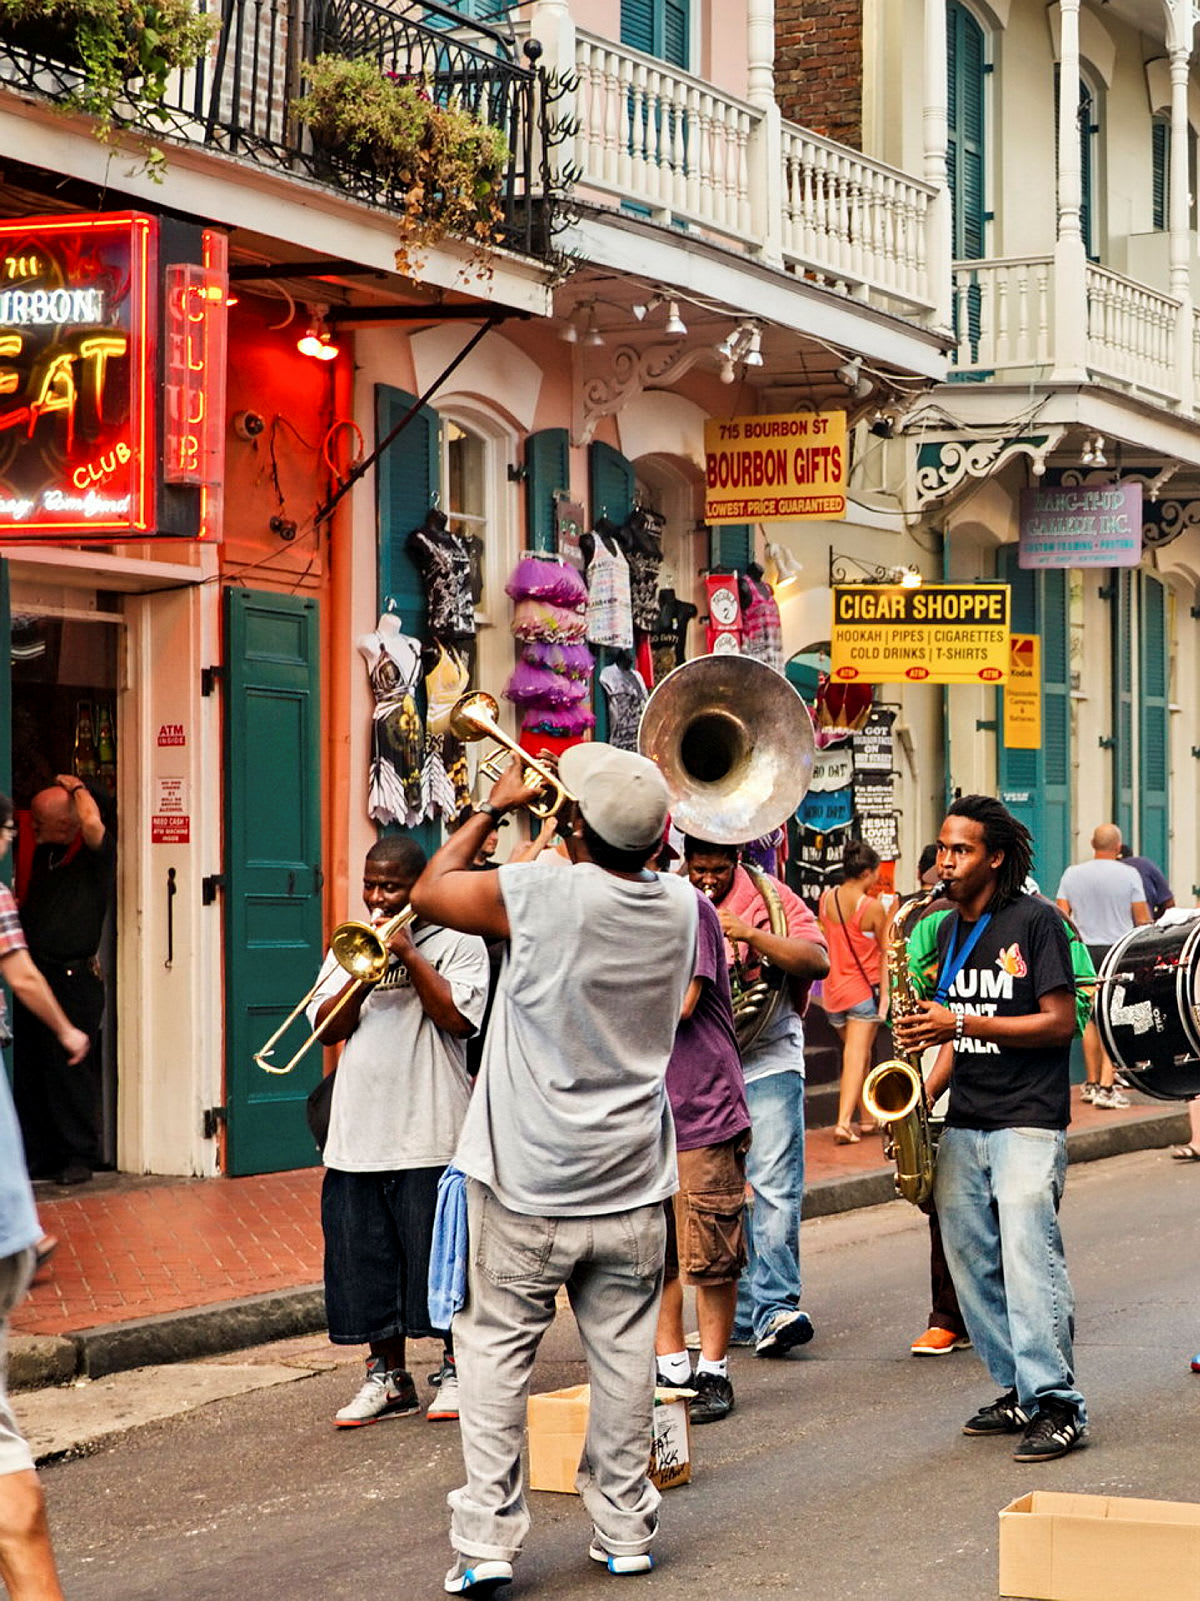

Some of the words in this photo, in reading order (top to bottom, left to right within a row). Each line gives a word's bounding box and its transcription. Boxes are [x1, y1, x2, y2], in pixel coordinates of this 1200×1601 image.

[720, 424, 740, 440] 715
[744, 420, 808, 438] BOURBON
[812, 419, 829, 434] ST
[73, 442, 131, 489] CLUB
[706, 449, 787, 489] BOURBON
[793, 445, 842, 485] GIFTS
[706, 502, 744, 517] LOWEST
[747, 501, 776, 515] PRICE
[778, 497, 842, 513] GUARANTEED
[839, 594, 906, 619] CIGAR
[912, 594, 1002, 620] SHOPPE
[836, 630, 882, 643] HOOKAH
[892, 631, 924, 642] PIPES
[934, 631, 1004, 643] CIGARETTES
[850, 648, 880, 660] COLD
[883, 648, 926, 660] DRINKS
[936, 648, 988, 661] T-SHIRTS
[839, 668, 857, 679] ATM
[909, 668, 927, 679] ATM
[981, 669, 1000, 680] ATM
[160, 725, 184, 735] ATM
[865, 726, 889, 735] GOT
[864, 745, 879, 753] ON
[861, 819, 895, 829] JESUS
[862, 829, 895, 839] LOVES
[867, 837, 892, 846] YOU!
